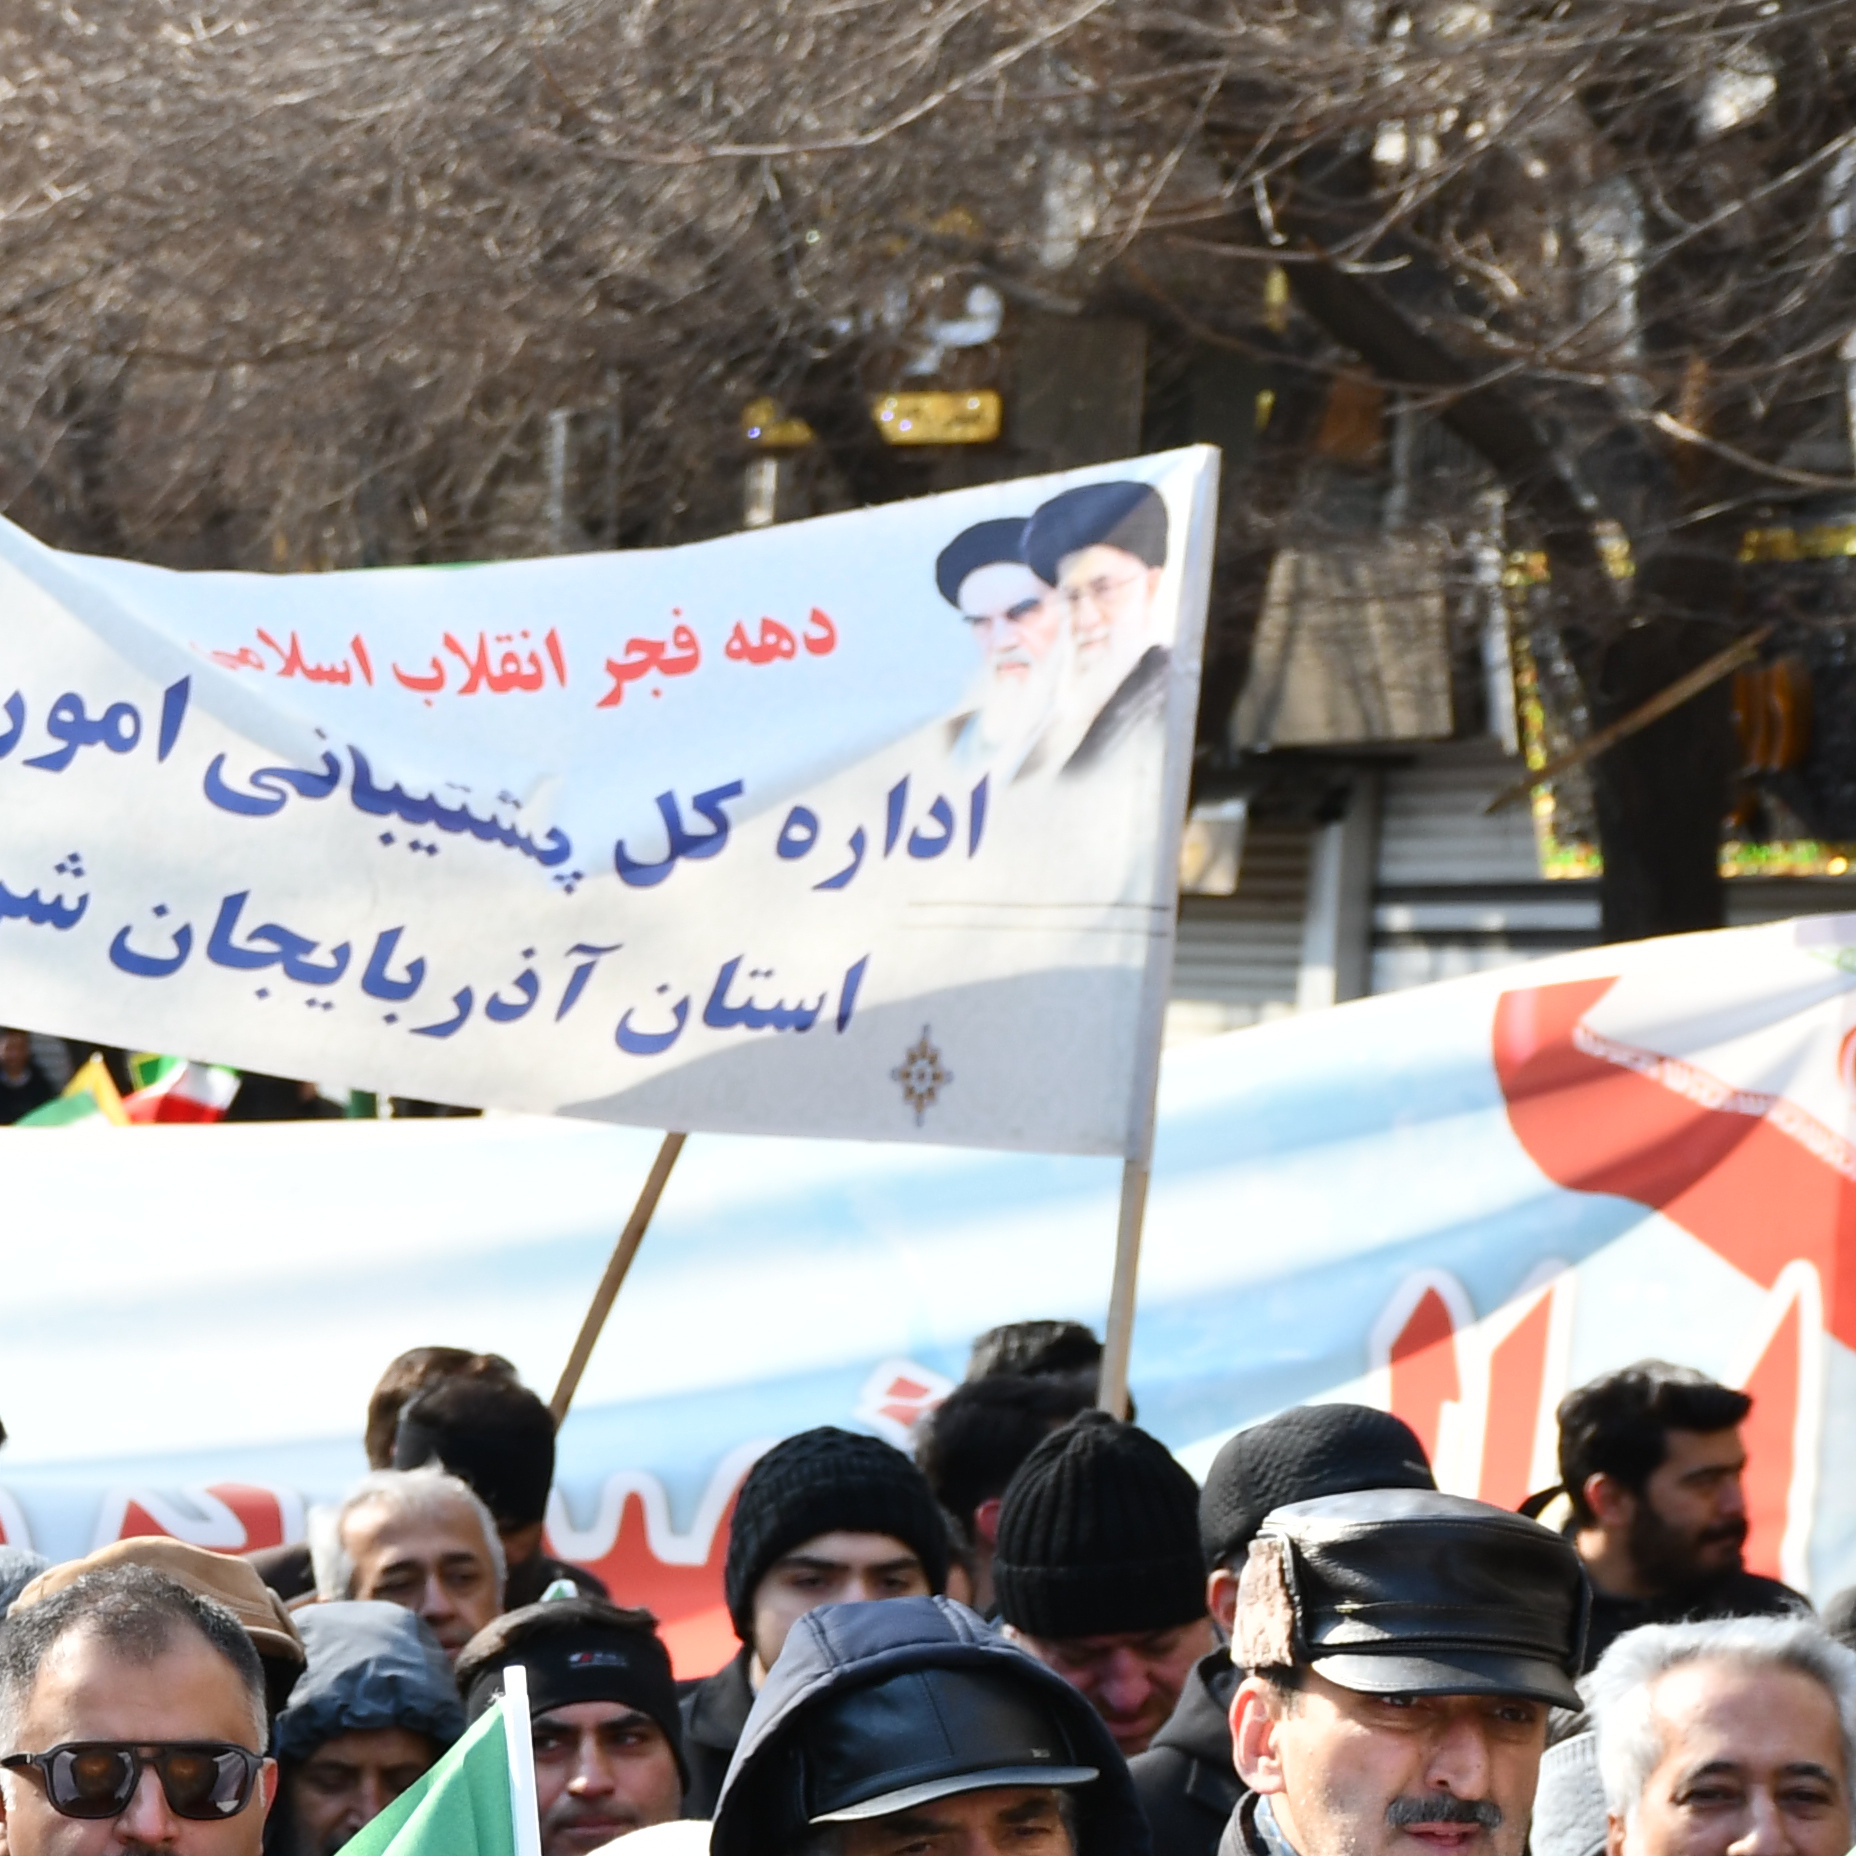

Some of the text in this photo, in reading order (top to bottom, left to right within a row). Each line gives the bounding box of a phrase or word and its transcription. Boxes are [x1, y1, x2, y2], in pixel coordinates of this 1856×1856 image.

[392, 627, 568, 706] انقلاب
[596, 606, 701, 709] فجر
[724, 605, 839, 666] دهه
[202, 727, 585, 896] پشتیبانی
[613, 779, 745, 888] کل
[774, 772, 989, 891] اداره
[108, 890, 624, 1039] آذربایجان
[612, 953, 871, 1056] استان
